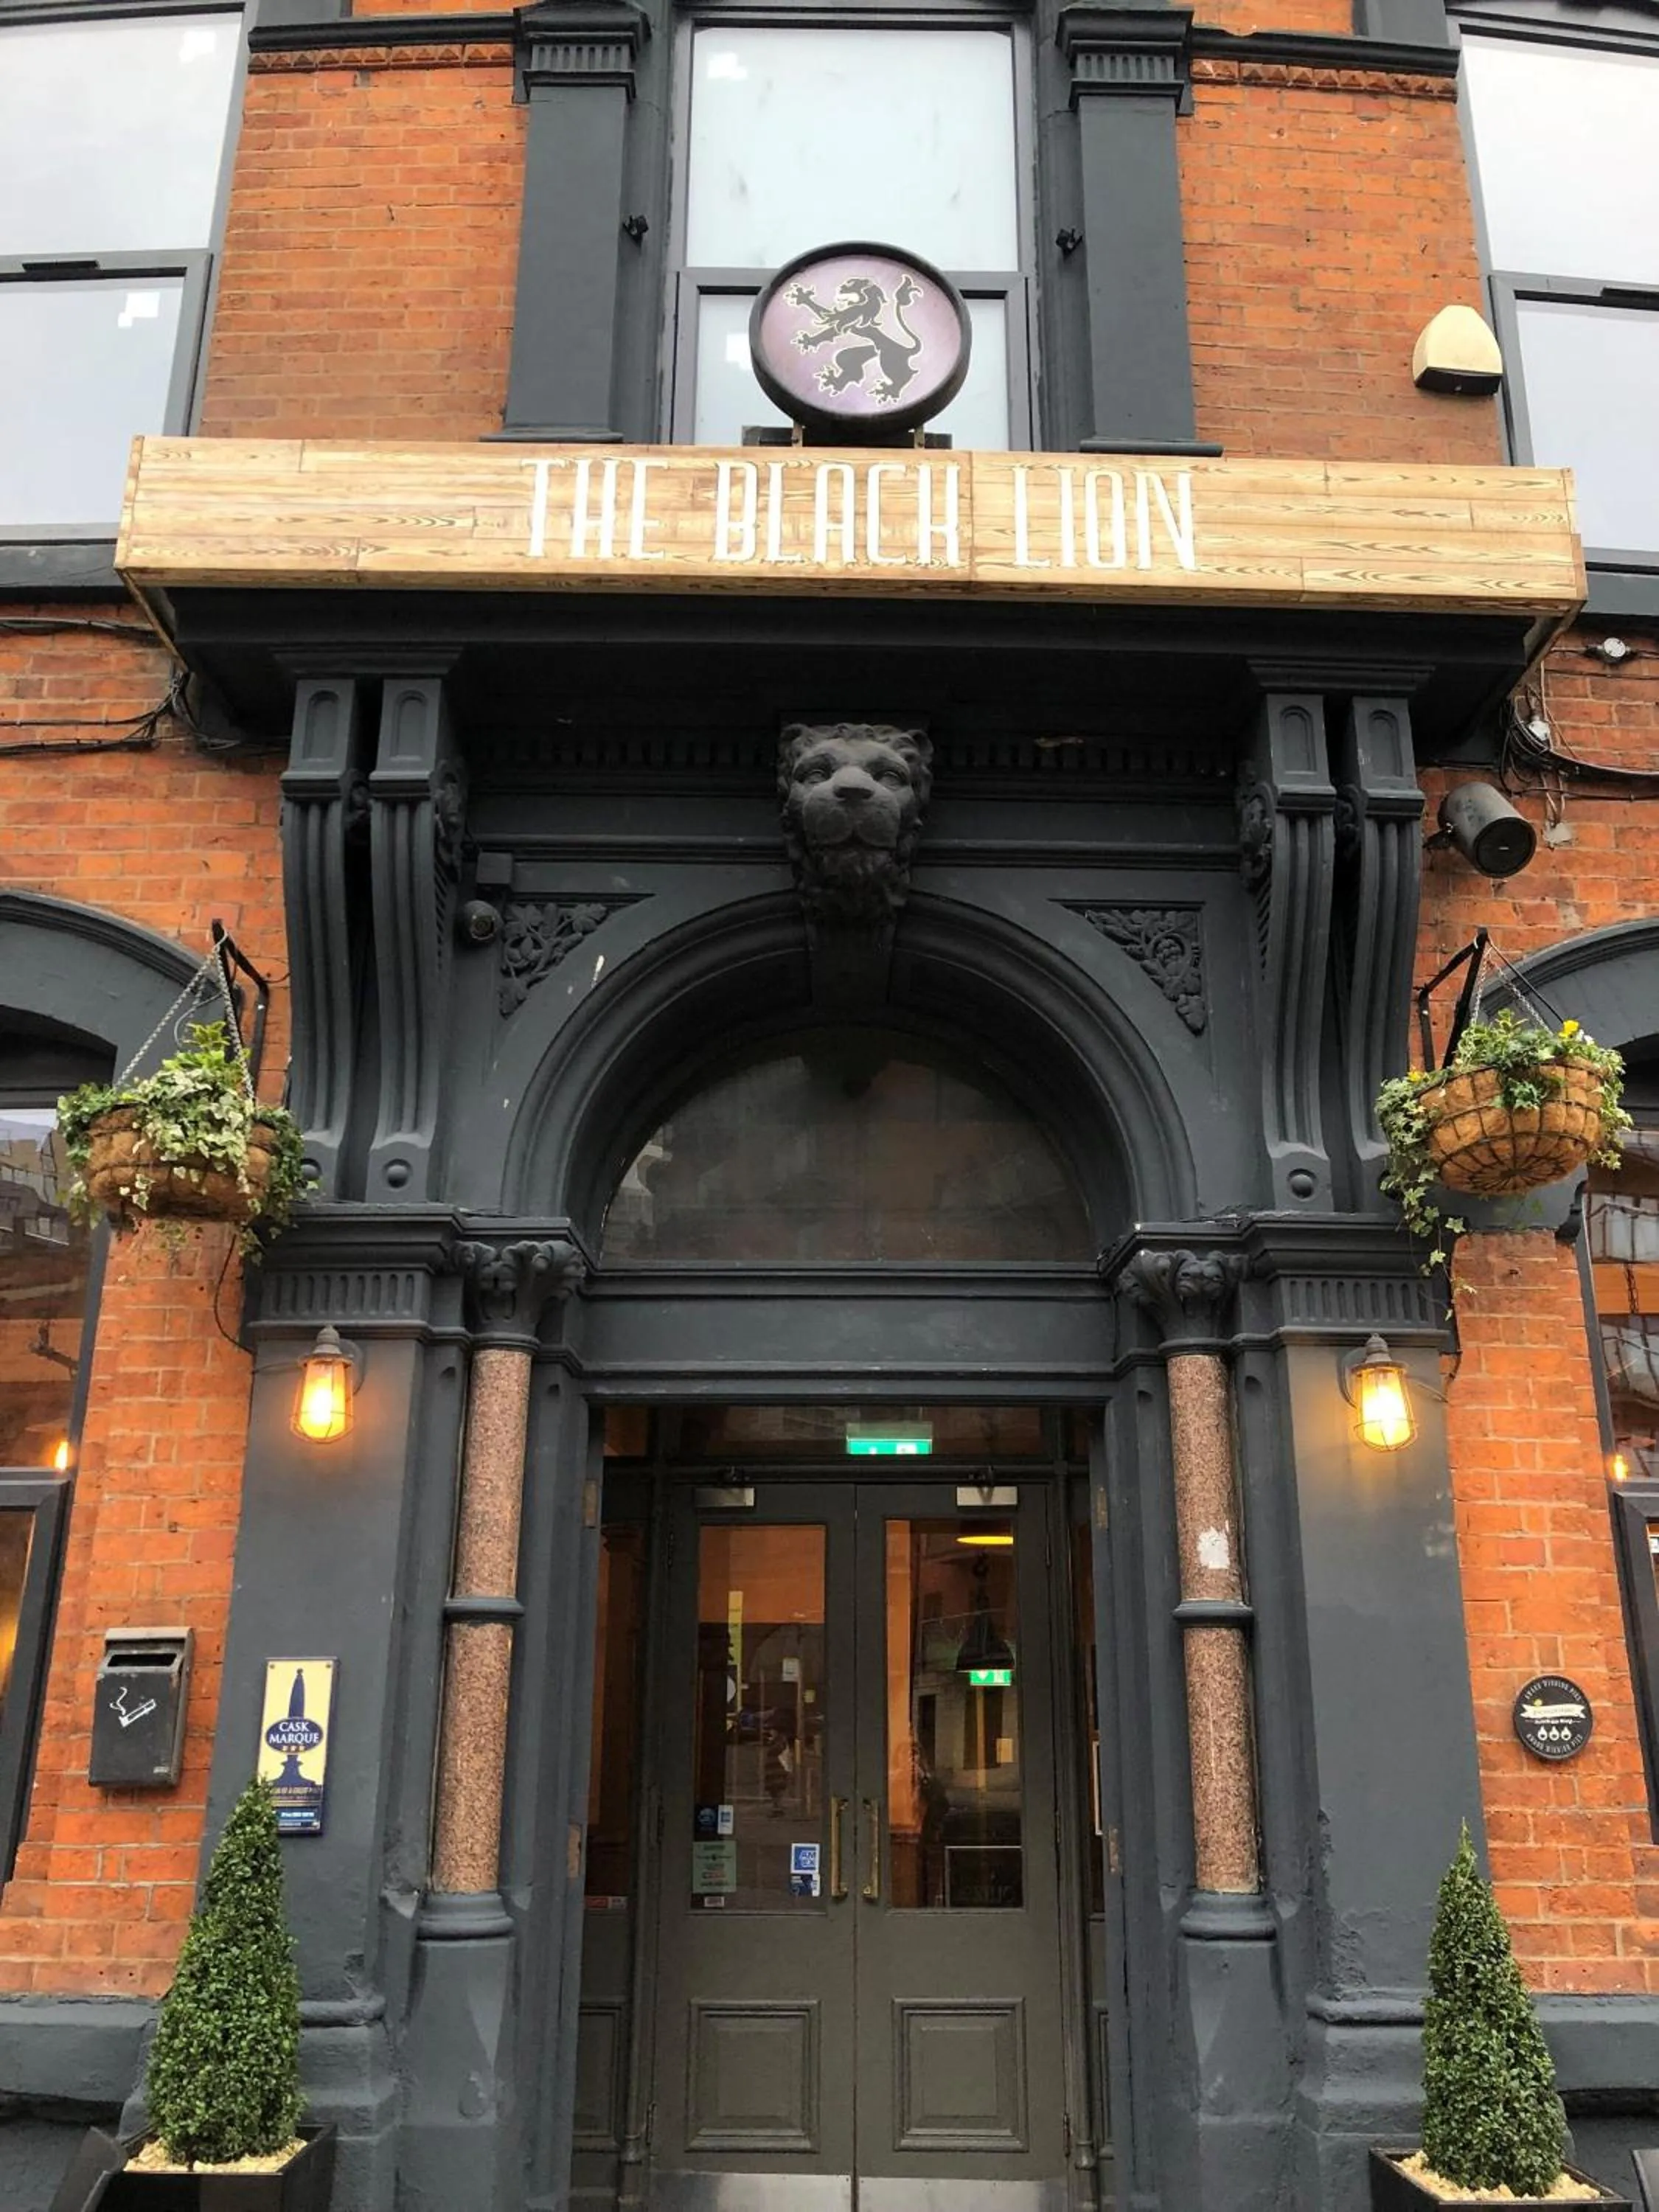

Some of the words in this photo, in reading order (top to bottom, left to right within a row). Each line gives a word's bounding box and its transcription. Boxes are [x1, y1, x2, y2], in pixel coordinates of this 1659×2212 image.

[519, 458, 669, 560] THE
[713, 459, 961, 568] BLACK
[1011, 464, 1199, 571] LION
[279, 1722, 310, 1732] CASK
[268, 1733, 319, 1744] MARQUE
